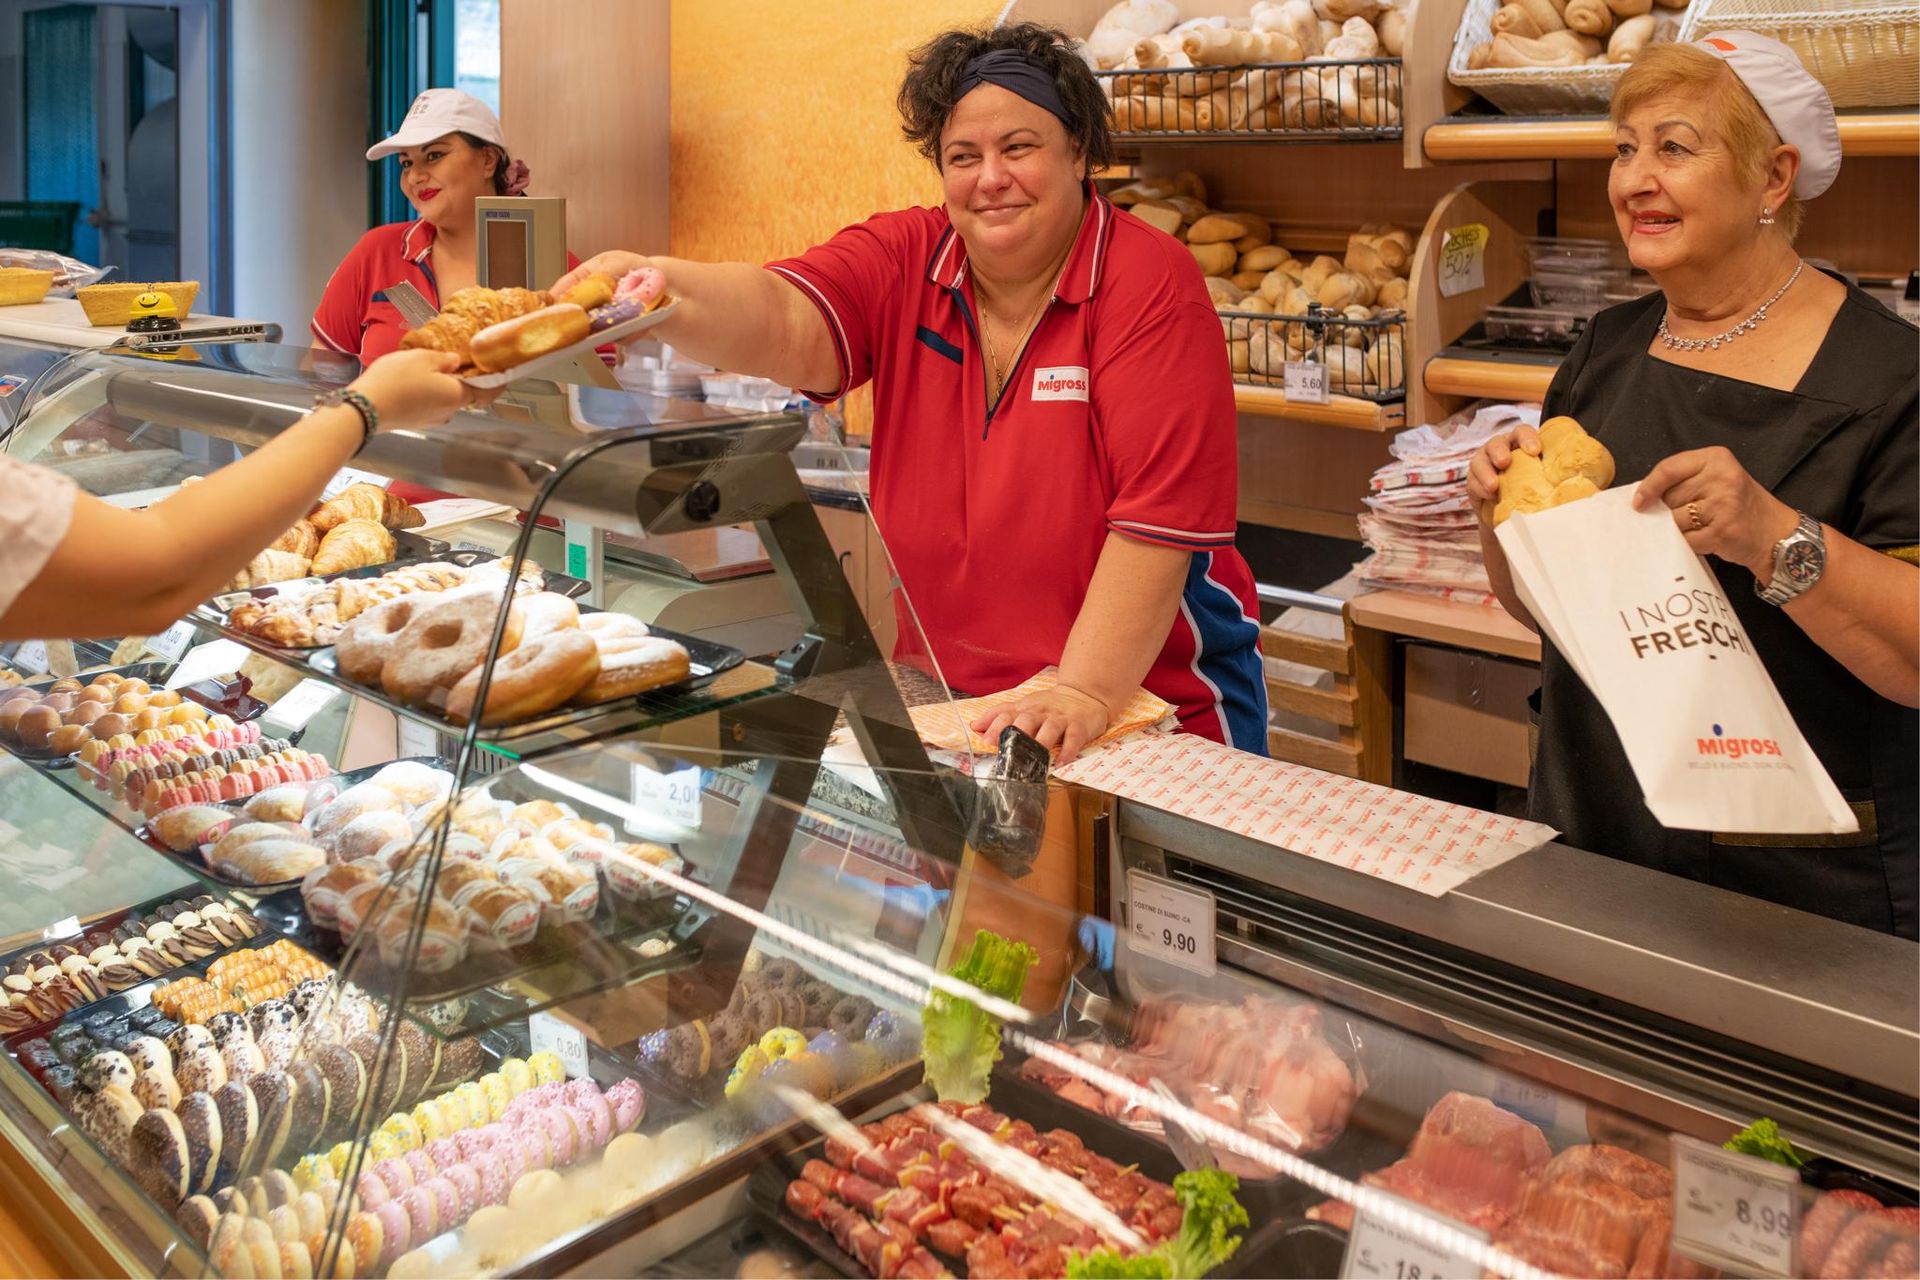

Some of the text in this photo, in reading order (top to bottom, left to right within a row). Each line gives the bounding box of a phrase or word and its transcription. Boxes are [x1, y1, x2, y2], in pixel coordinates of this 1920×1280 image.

[1037, 374, 1087, 393] Migross
[1636, 588, 1735, 629] NOSTR
[1162, 928, 1196, 954] 9,90
[1735, 1196, 1792, 1240] 8,99
